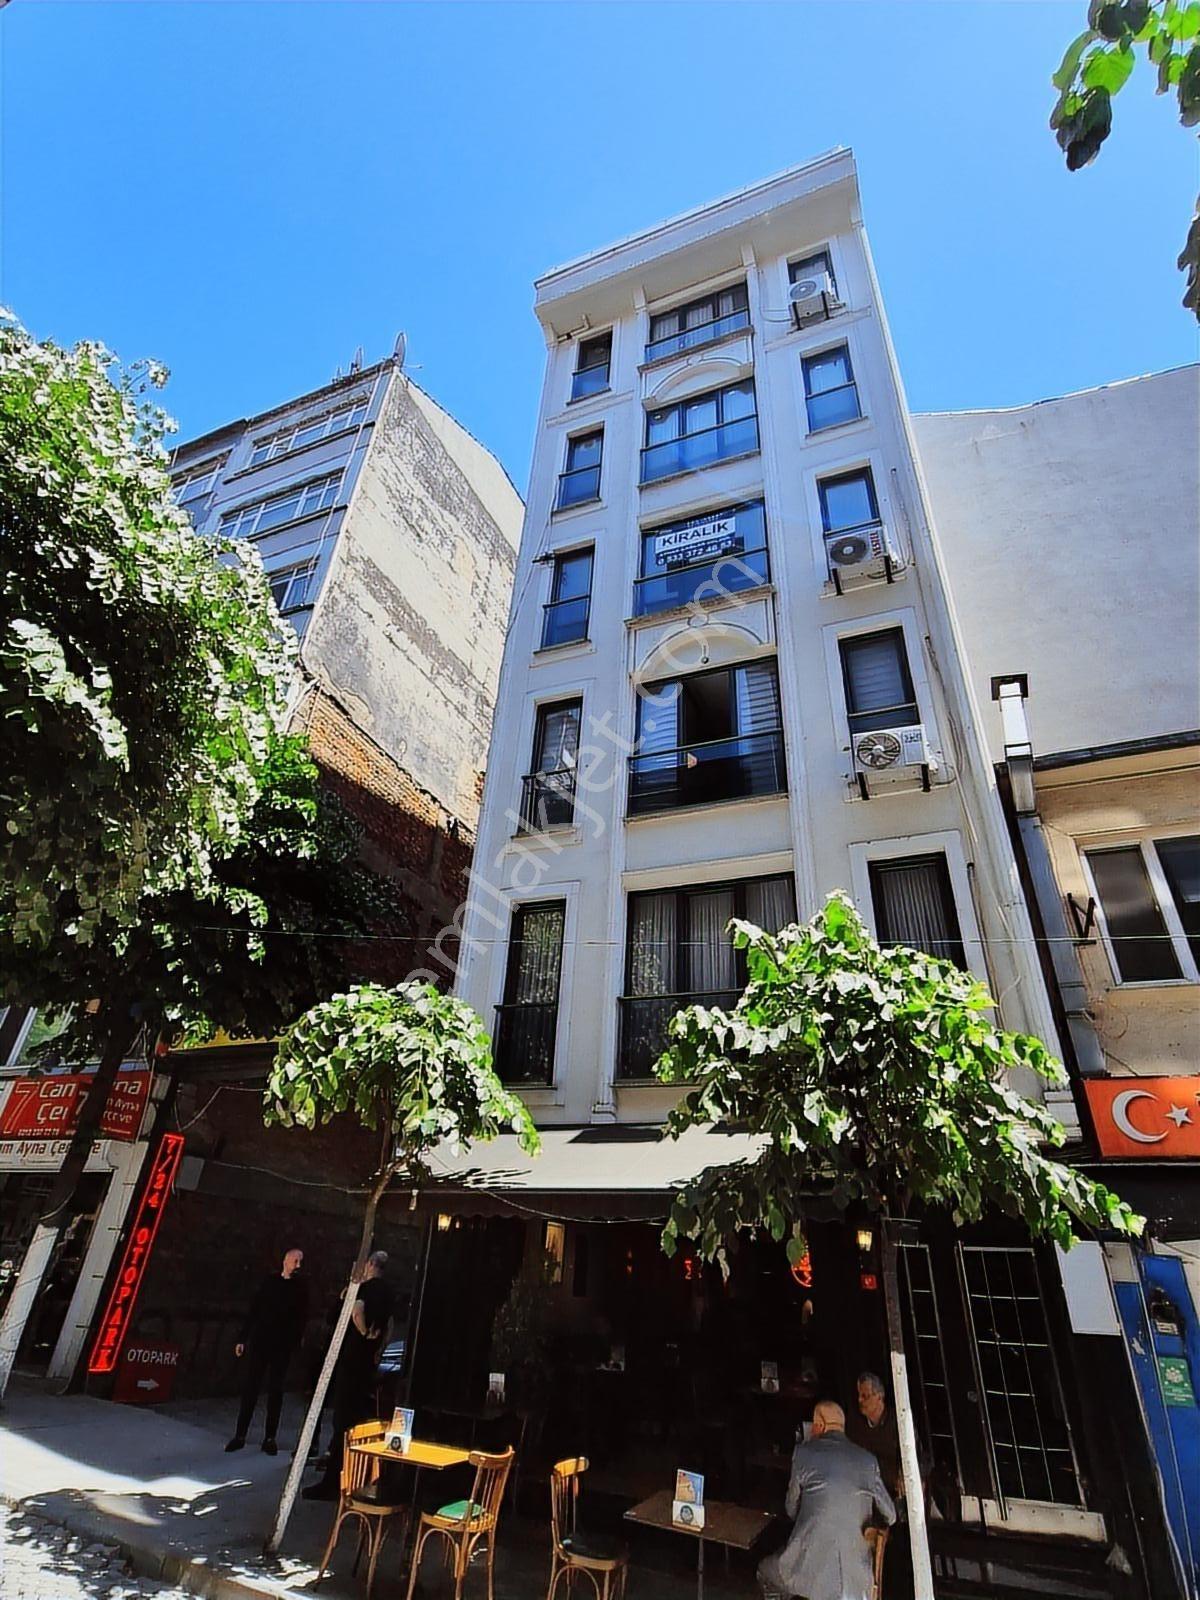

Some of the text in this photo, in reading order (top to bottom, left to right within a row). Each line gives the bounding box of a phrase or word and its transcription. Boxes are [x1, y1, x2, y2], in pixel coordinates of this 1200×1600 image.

[16, 1141, 47, 1158] Ayna
[95, 1227, 150, 1369] OTOPARK
[127, 1348, 179, 1366] OTOPARK
